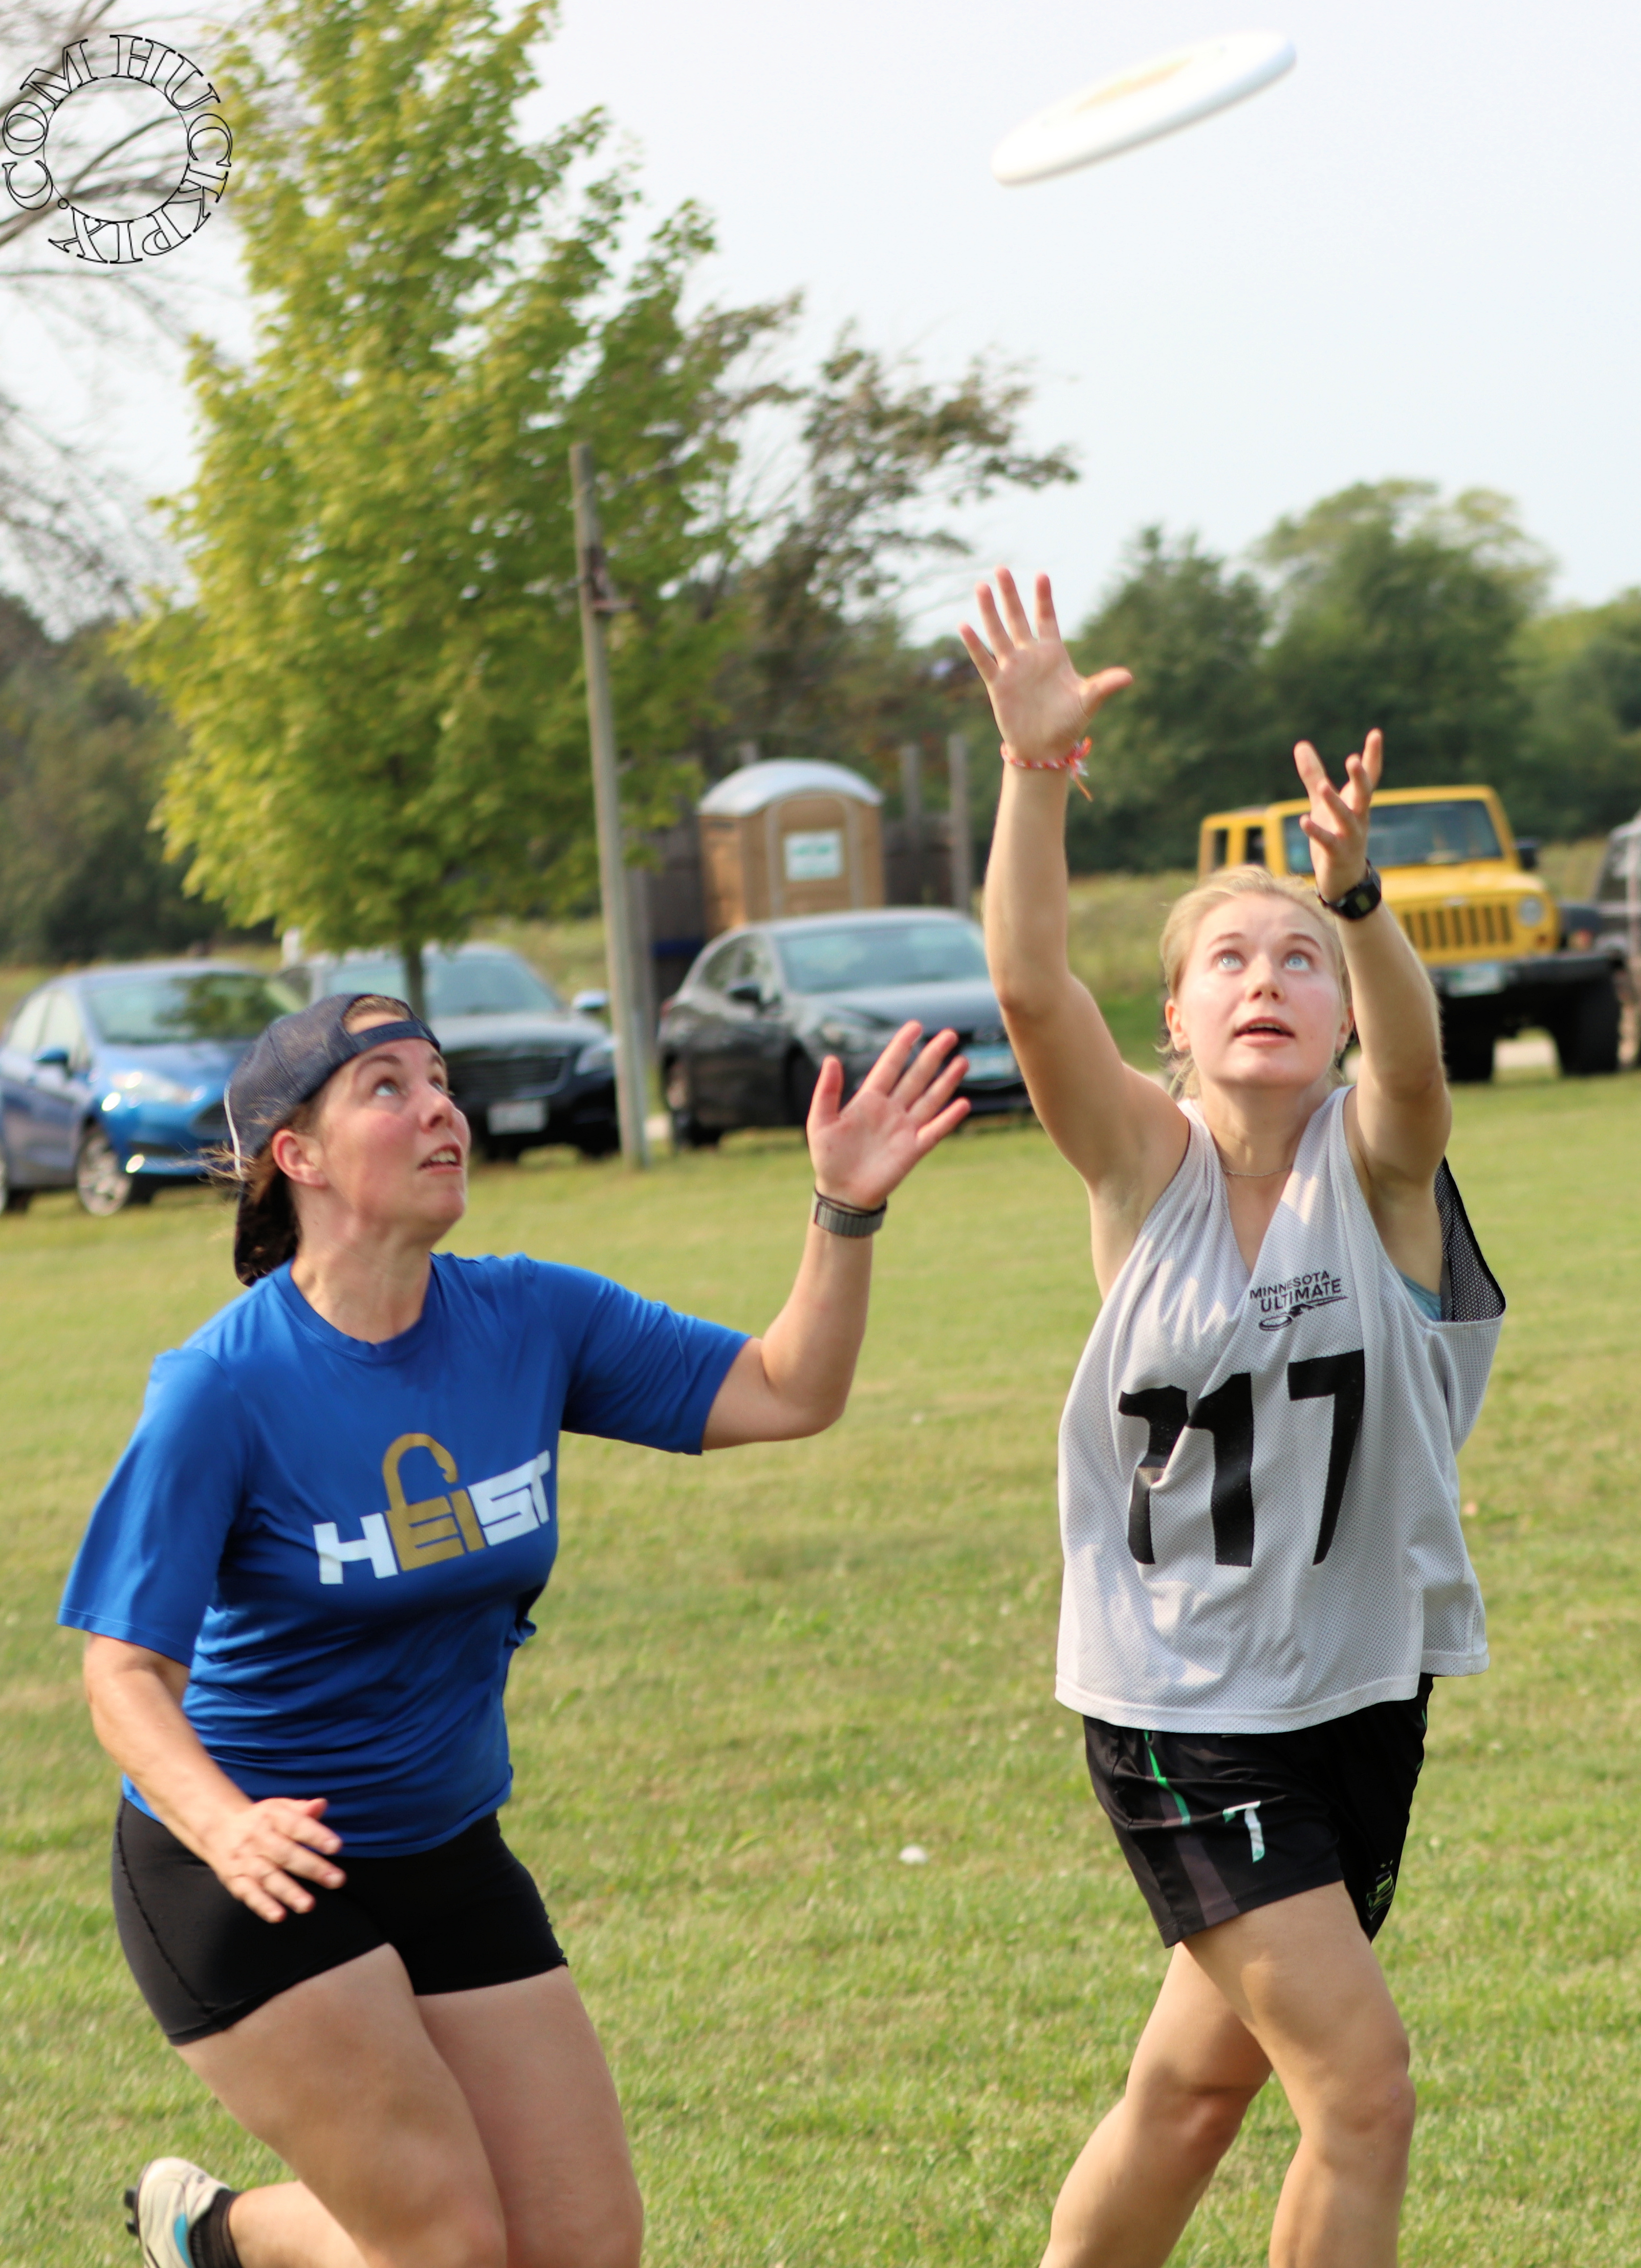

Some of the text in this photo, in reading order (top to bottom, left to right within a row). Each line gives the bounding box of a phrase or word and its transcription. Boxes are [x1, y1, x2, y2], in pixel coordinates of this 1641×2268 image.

[1249, 1270, 1330, 1299] MINNESOTA
[1260, 1278, 1342, 1312] ULTIMATE
[313, 1449, 551, 1585] HEIST
